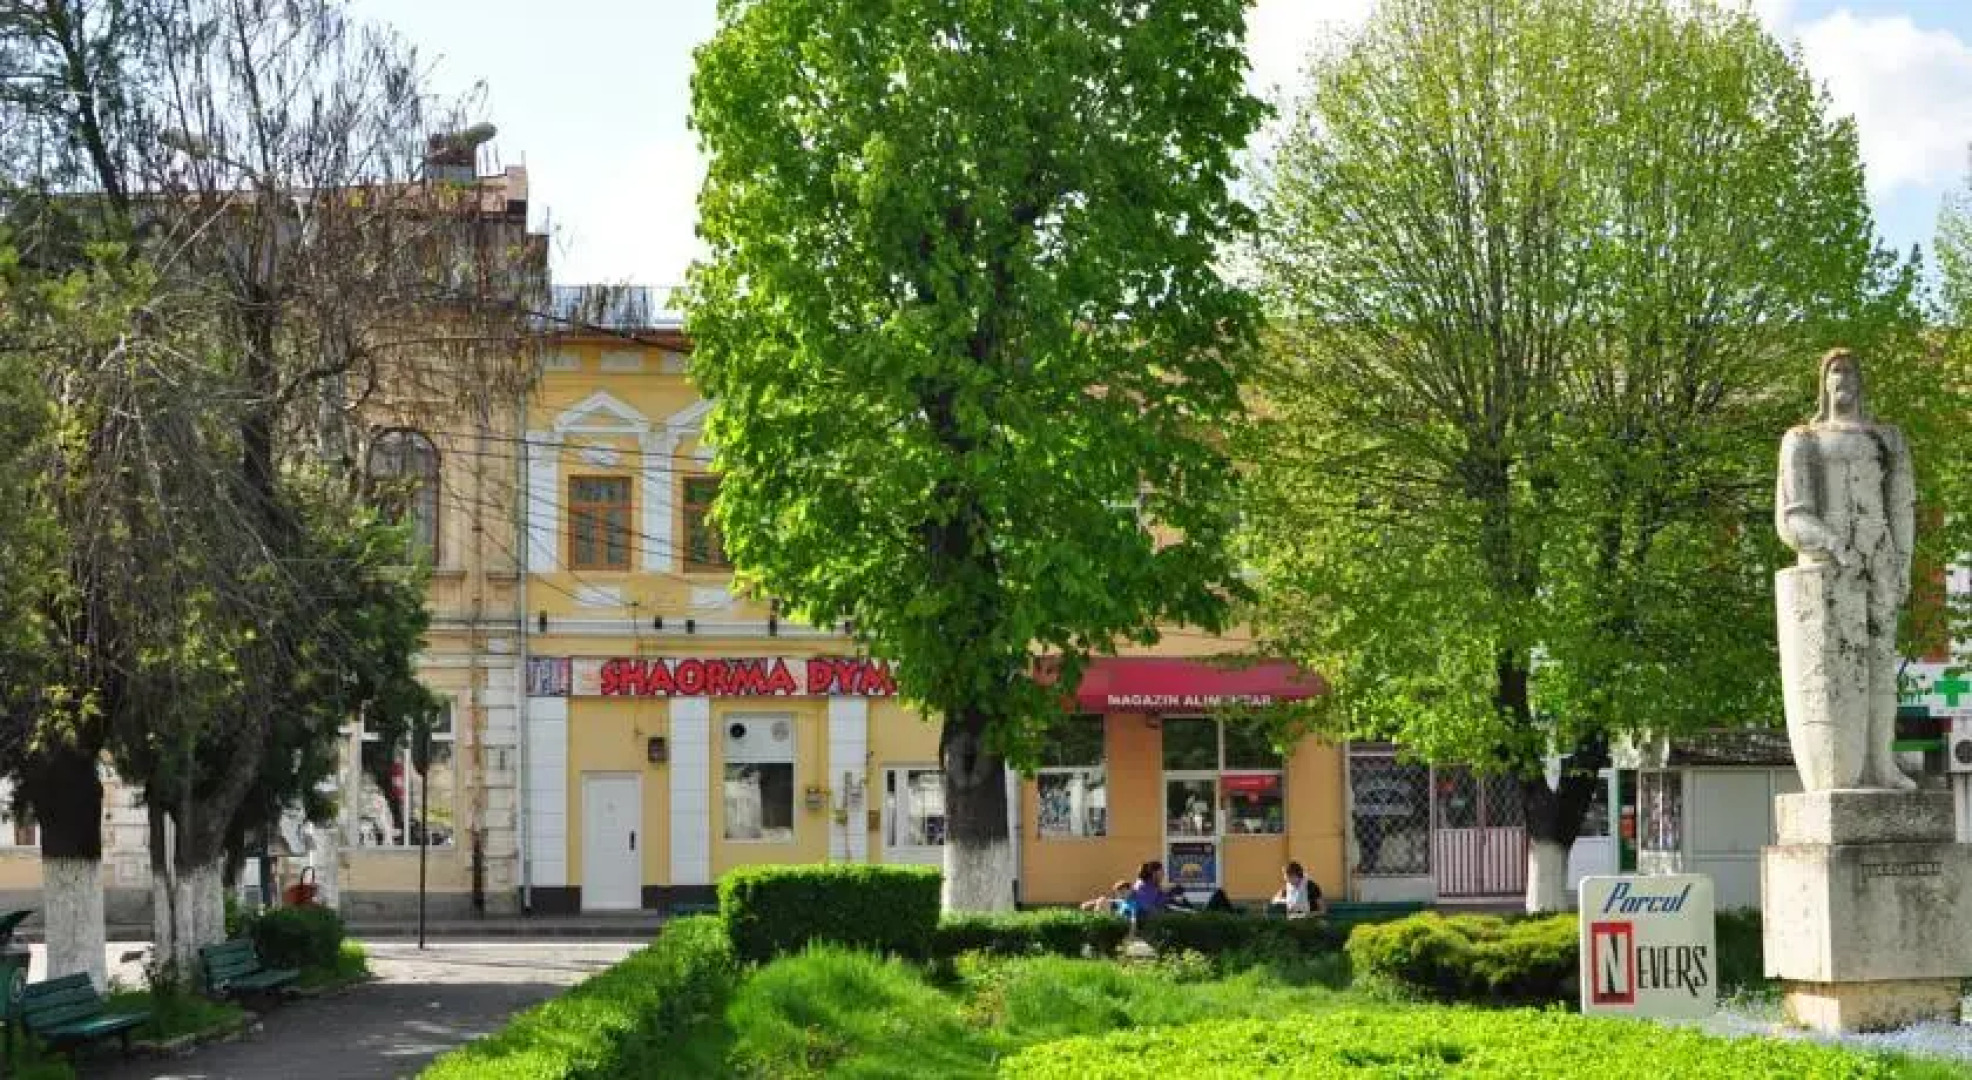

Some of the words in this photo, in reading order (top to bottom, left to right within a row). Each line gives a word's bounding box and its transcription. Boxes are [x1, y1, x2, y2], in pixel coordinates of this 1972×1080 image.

[601, 656, 797, 696] SHAORMA
[1107, 694, 1180, 706] MAGAZIN
[1183, 694, 1272, 707] ALIMNTAR
[1603, 882, 1693, 914] Parcul
[1595, 931, 1708, 997] NEVERS
